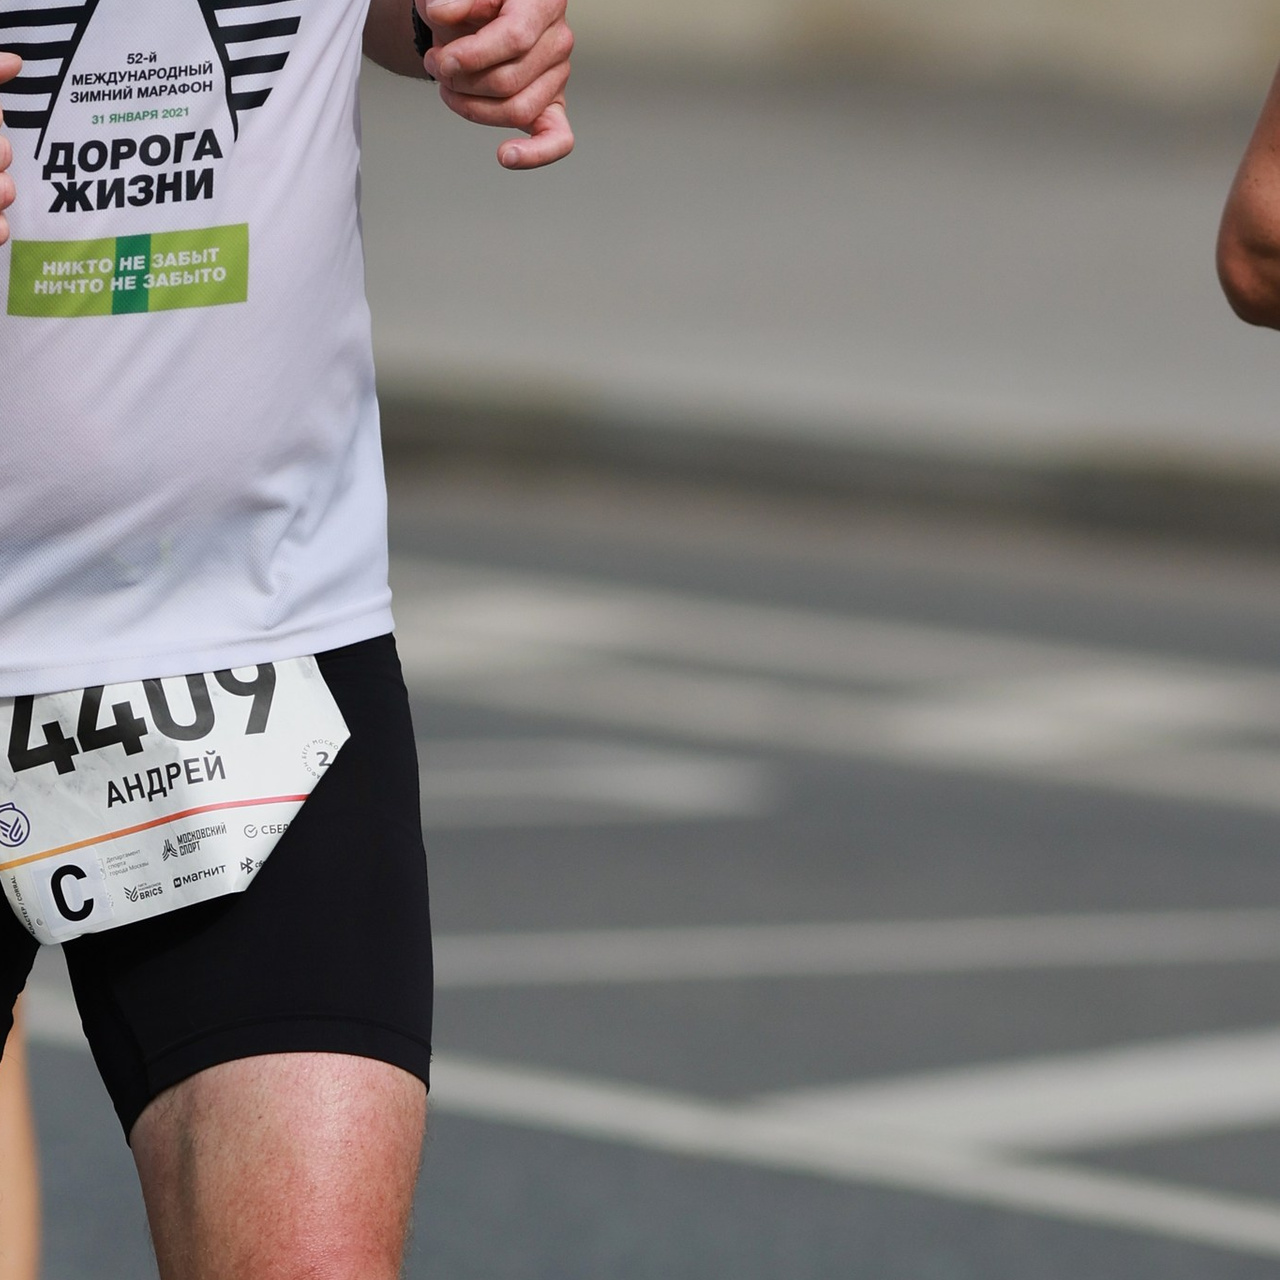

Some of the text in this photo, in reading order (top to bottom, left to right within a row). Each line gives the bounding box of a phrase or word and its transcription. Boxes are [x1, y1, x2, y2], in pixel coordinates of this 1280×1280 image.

[126, 51, 157, 65] 52-й
[71, 60, 213, 86] МЕЖДУНАРОДНЫЙ
[70, 80, 213, 103] ЗИМНИЙ МАРАФОН
[92, 107, 189, 125] 31 ЯНВАРЯ 2021
[42, 128, 224, 180] ДОРОГА
[48, 168, 214, 213] ЖИЗНИ
[42, 247, 220, 276] НИКТО НЕ ЗАБЫТ
[34, 267, 227, 295] НИЧТО НЕ ЗАБЫТО
[7, 661, 277, 776] 4409
[106, 750, 227, 808] АНДРЕЙ
[176, 822, 227, 846] МОСКОВСКИЙ
[179, 841, 201, 857] СПОРТ
[140, 886, 163, 900] BRICS
